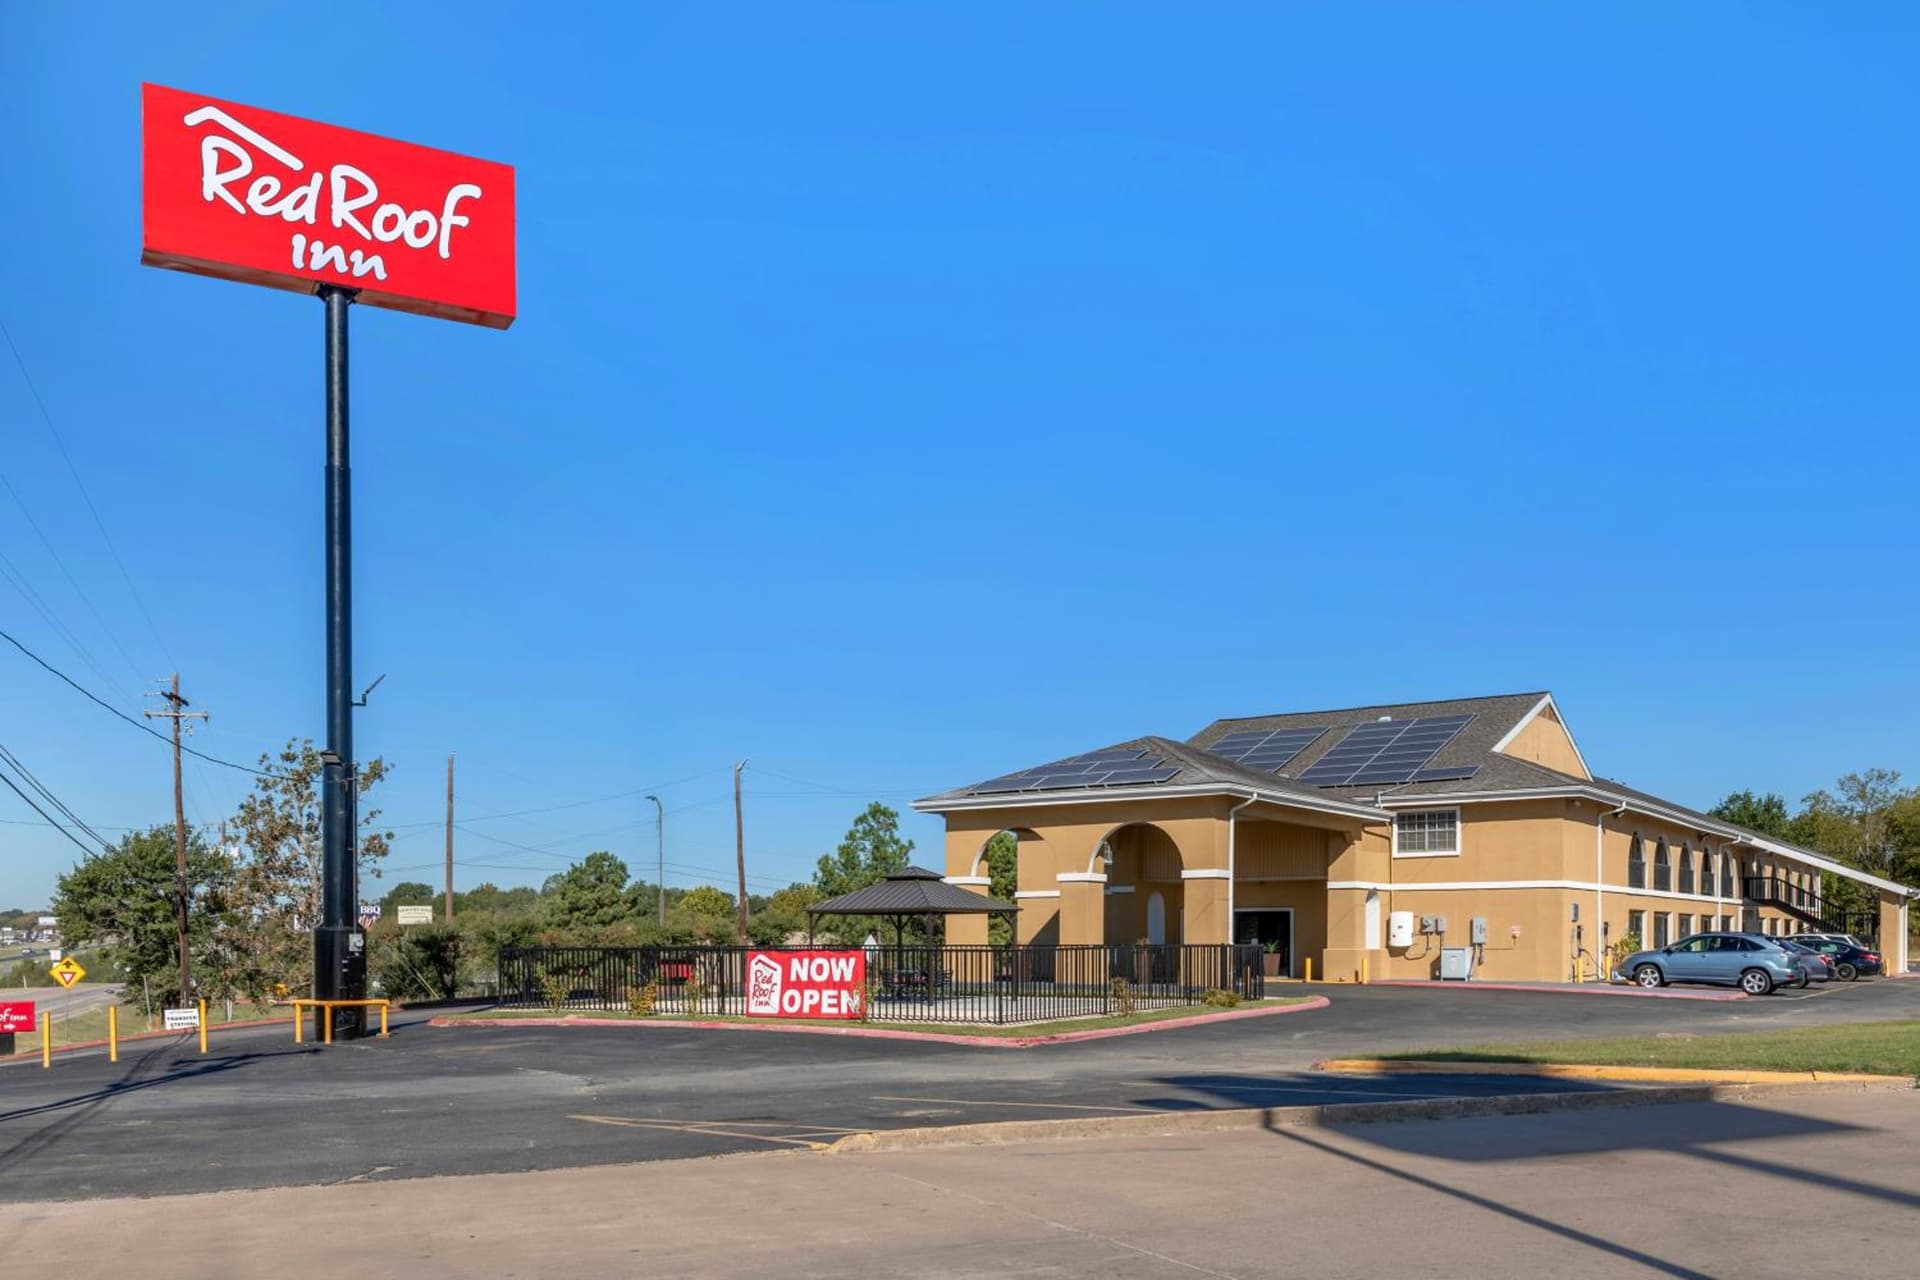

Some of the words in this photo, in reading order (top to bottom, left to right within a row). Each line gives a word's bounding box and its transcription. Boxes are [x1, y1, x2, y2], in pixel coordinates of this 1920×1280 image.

[201, 135, 323, 225] Red
[330, 164, 482, 259] Roof
[360, 905, 381, 914] BBQ
[754, 969, 774, 985] Red
[790, 957, 856, 982] NOW
[752, 983, 777, 1000] Roof
[782, 989, 860, 1015] OPEN
